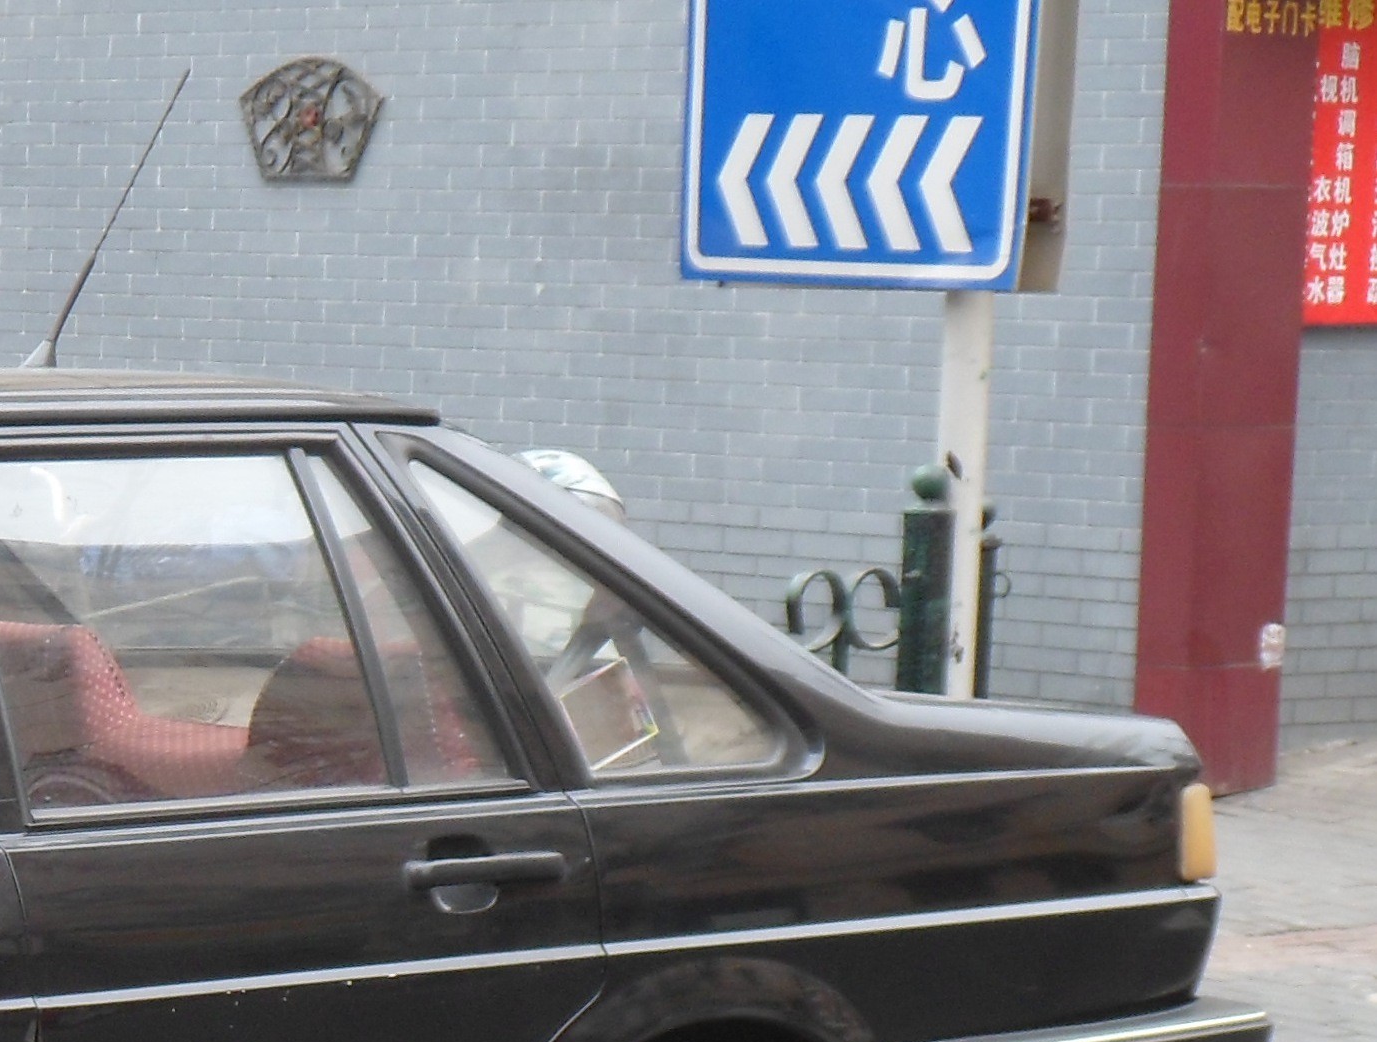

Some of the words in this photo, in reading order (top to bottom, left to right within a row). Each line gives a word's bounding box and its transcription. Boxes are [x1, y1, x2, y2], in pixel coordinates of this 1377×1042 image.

[878, 0, 986, 100] 心
[1313, 74, 1359, 104] 视机
[1307, 175, 1352, 204] 衣机
[1305, 208, 1350, 237] 波炉
[1303, 243, 1347, 271] 气灶
[1301, 276, 1346, 305] 水器
